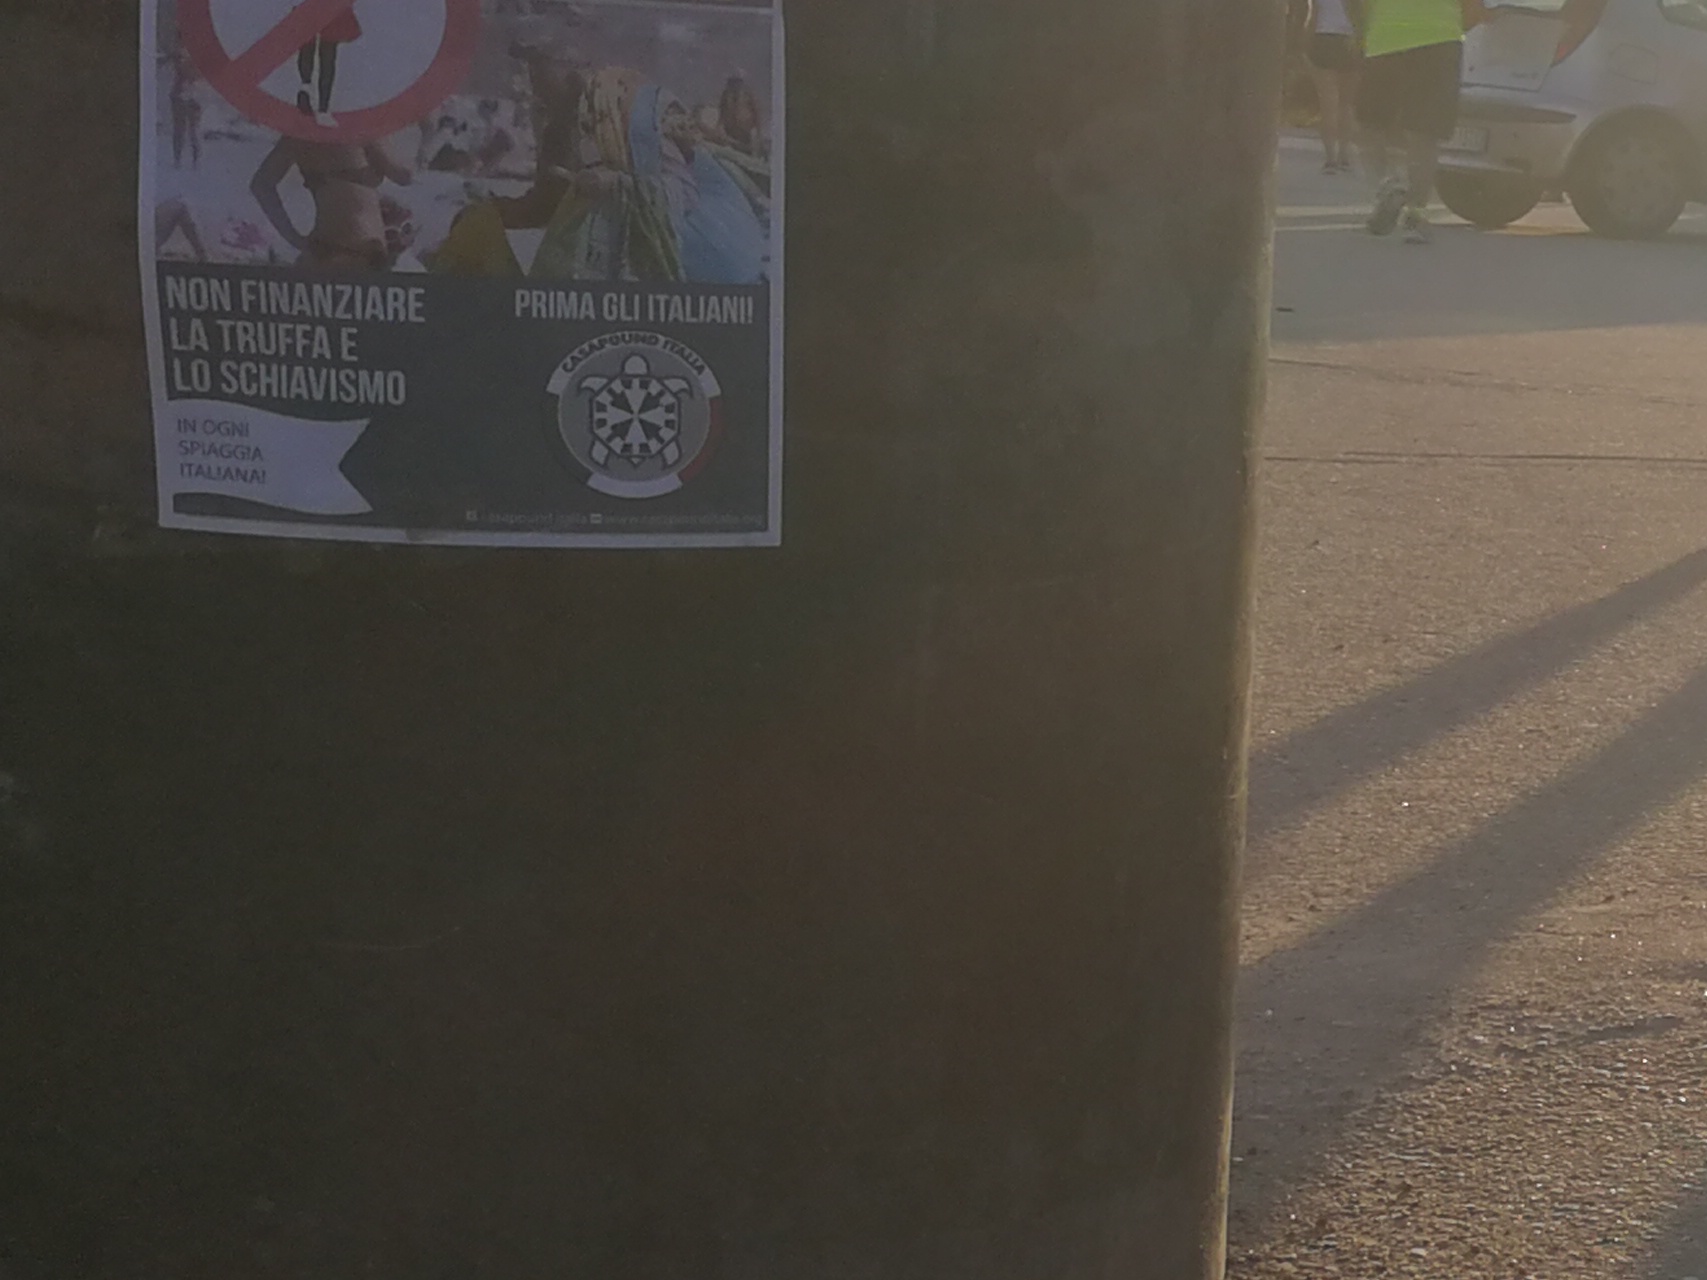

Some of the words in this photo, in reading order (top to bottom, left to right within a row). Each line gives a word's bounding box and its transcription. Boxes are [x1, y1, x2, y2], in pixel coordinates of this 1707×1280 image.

[165, 275, 234, 314] NON
[240, 279, 426, 323] FINANZIARE
[514, 288, 596, 321] PRIMA
[602, 291, 640, 322] GLI
[646, 292, 754, 325] ITALIANI!
[168, 317, 211, 352] LA
[217, 320, 332, 361] TRUFFA
[340, 325, 359, 362] E
[561, 332, 659, 374] CASAPOUND
[662, 339, 707, 376] ITALIA
[173, 356, 213, 395] LO
[219, 361, 407, 406] SCHIAVISMO
[177, 418, 197, 434] IN
[202, 419, 250, 438] OGNI
[177, 439, 265, 462] SPIAGGIA
[179, 463, 267, 485] ITALIANA!
